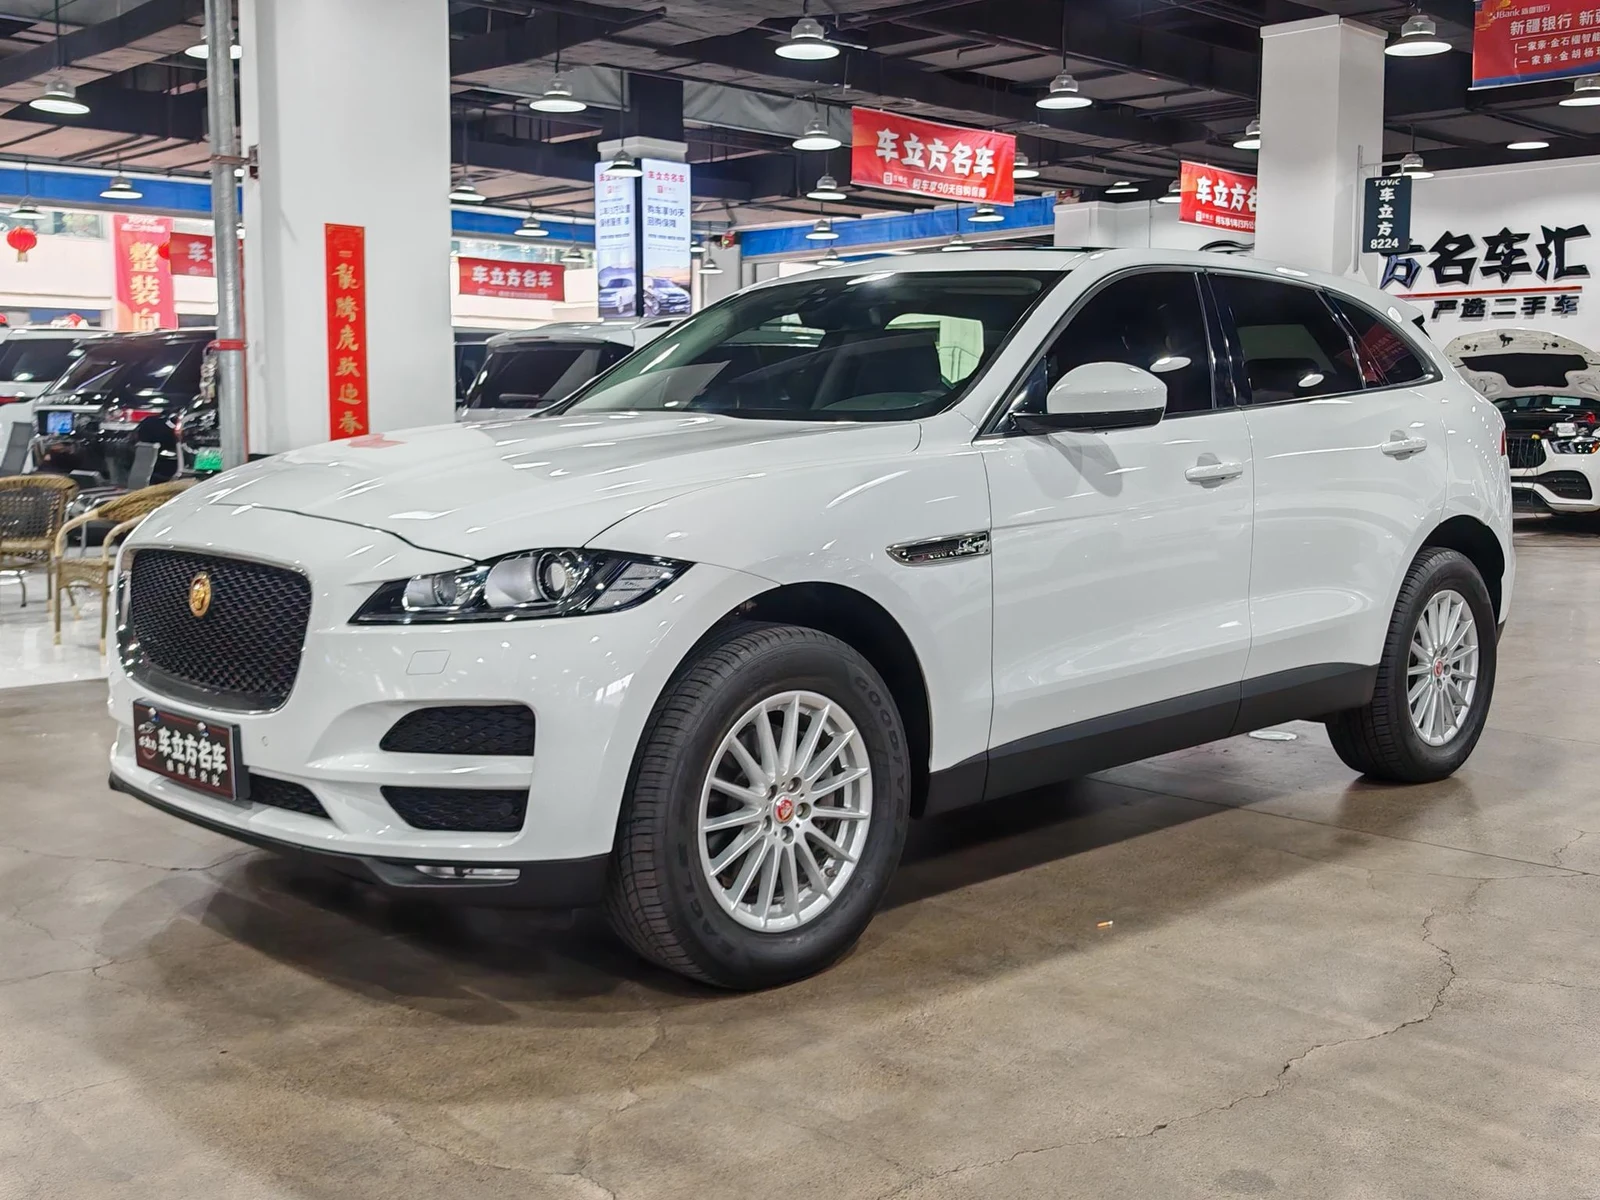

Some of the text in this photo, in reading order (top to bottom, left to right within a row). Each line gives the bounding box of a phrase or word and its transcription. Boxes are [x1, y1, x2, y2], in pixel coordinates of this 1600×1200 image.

[1510, 13, 1572, 36] 新疆银行
[876, 128, 995, 178] 车立方名车
[1377, 187, 1395, 237] 车立方
[188, 241, 213, 263] 车
[1370, 238, 1399, 249] 8224
[129, 241, 160, 330] 整装向
[472, 265, 553, 288] 车立方名车
[1431, 294, 1580, 320] 严选二手车
[158, 727, 228, 774] 车立方名车
